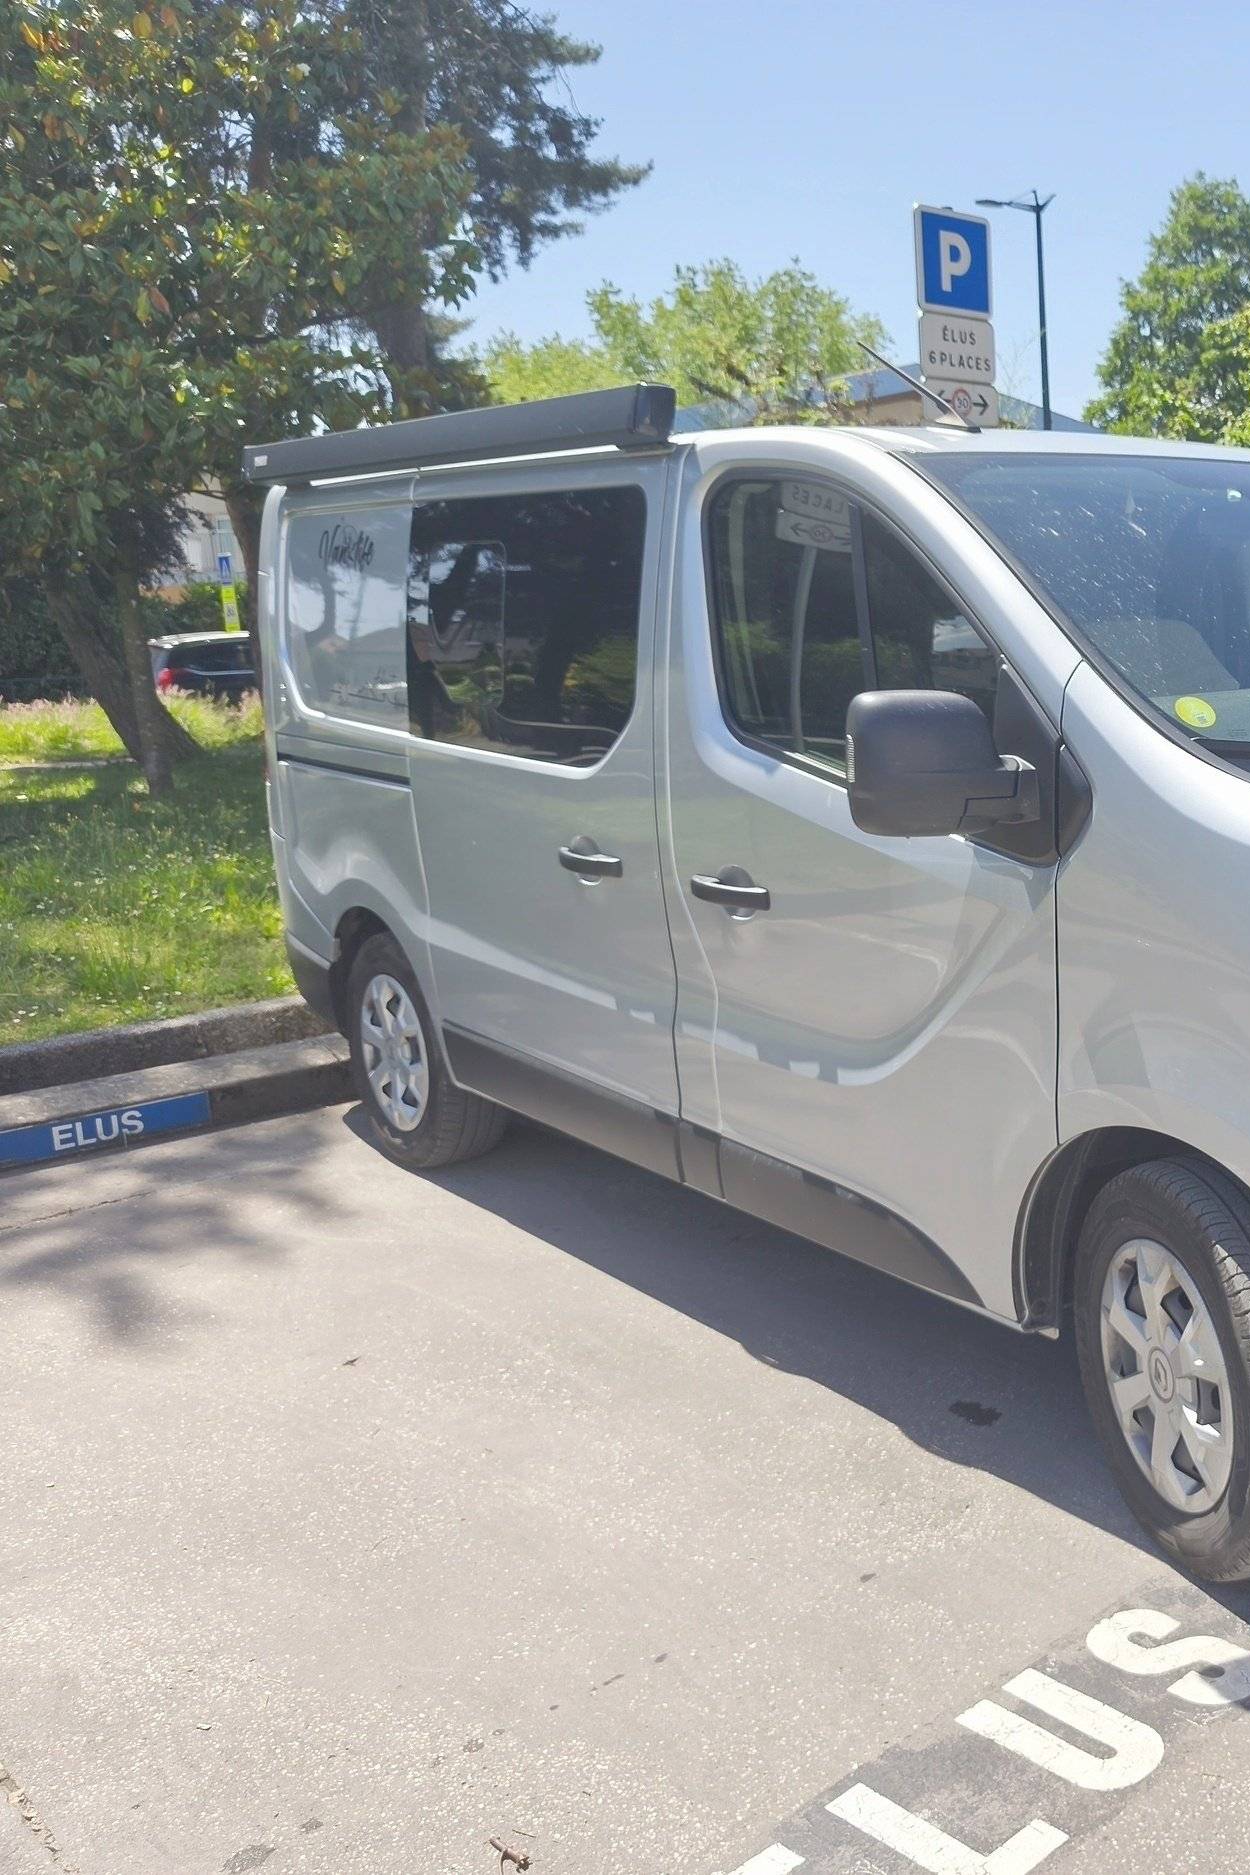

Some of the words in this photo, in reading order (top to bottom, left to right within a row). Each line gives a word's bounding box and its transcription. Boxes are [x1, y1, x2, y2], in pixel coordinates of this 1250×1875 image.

[938, 229, 972, 293] P
[942, 324, 977, 346] ÉLUS
[52, 1110, 145, 1151] ELUS
